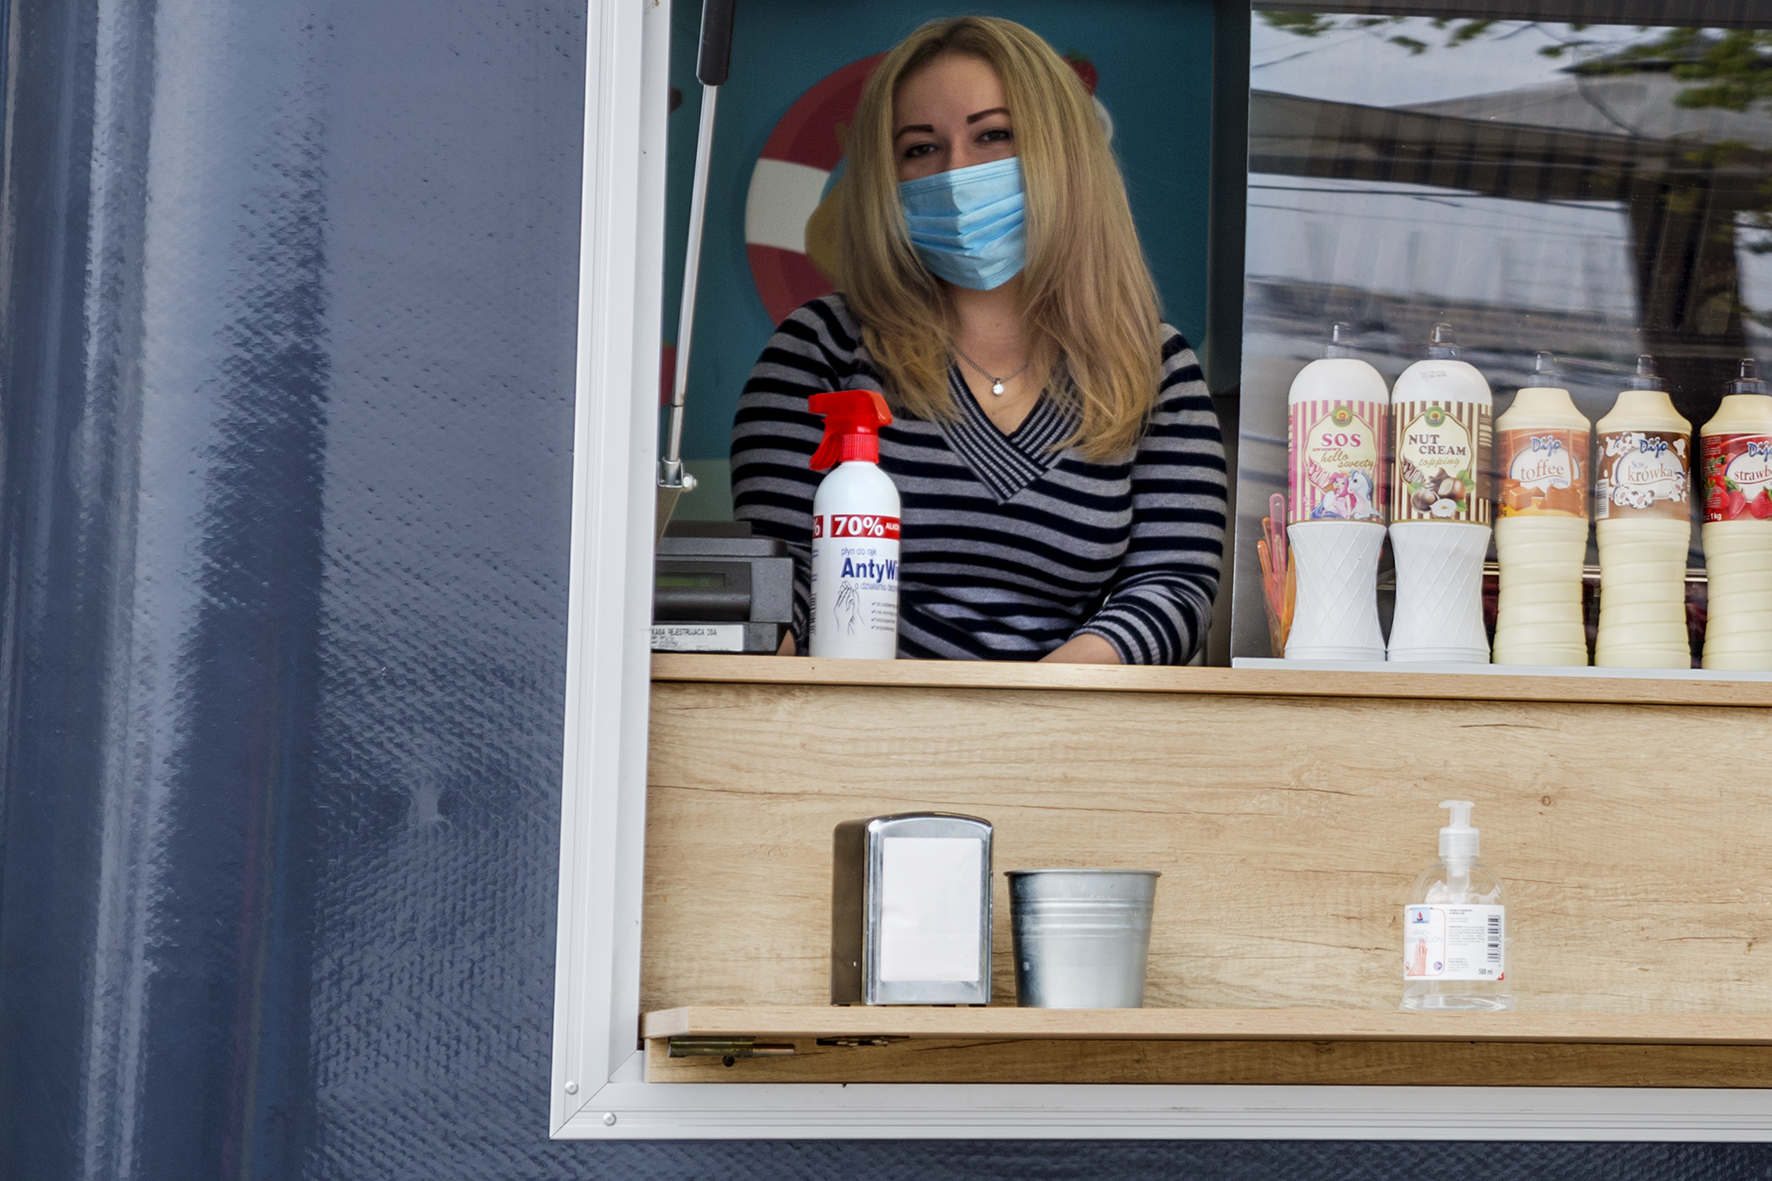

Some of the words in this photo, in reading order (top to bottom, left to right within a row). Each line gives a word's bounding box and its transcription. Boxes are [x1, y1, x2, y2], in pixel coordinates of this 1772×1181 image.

[1321, 433, 1361, 447] SOS
[1408, 434, 1440, 445] NUT
[1419, 445, 1466, 456] CREAM
[1531, 436, 1561, 457] Dijo
[1640, 437, 1668, 458] Dijo
[1321, 450, 1349, 463] hello
[1418, 457, 1460, 469] topping
[1337, 459, 1374, 471] sweety
[1520, 459, 1564, 481] toffee
[834, 516, 884, 536] 70%
[841, 547, 855, 558] płyn
[857, 547, 865, 555] do
[867, 547, 877, 557] rąk
